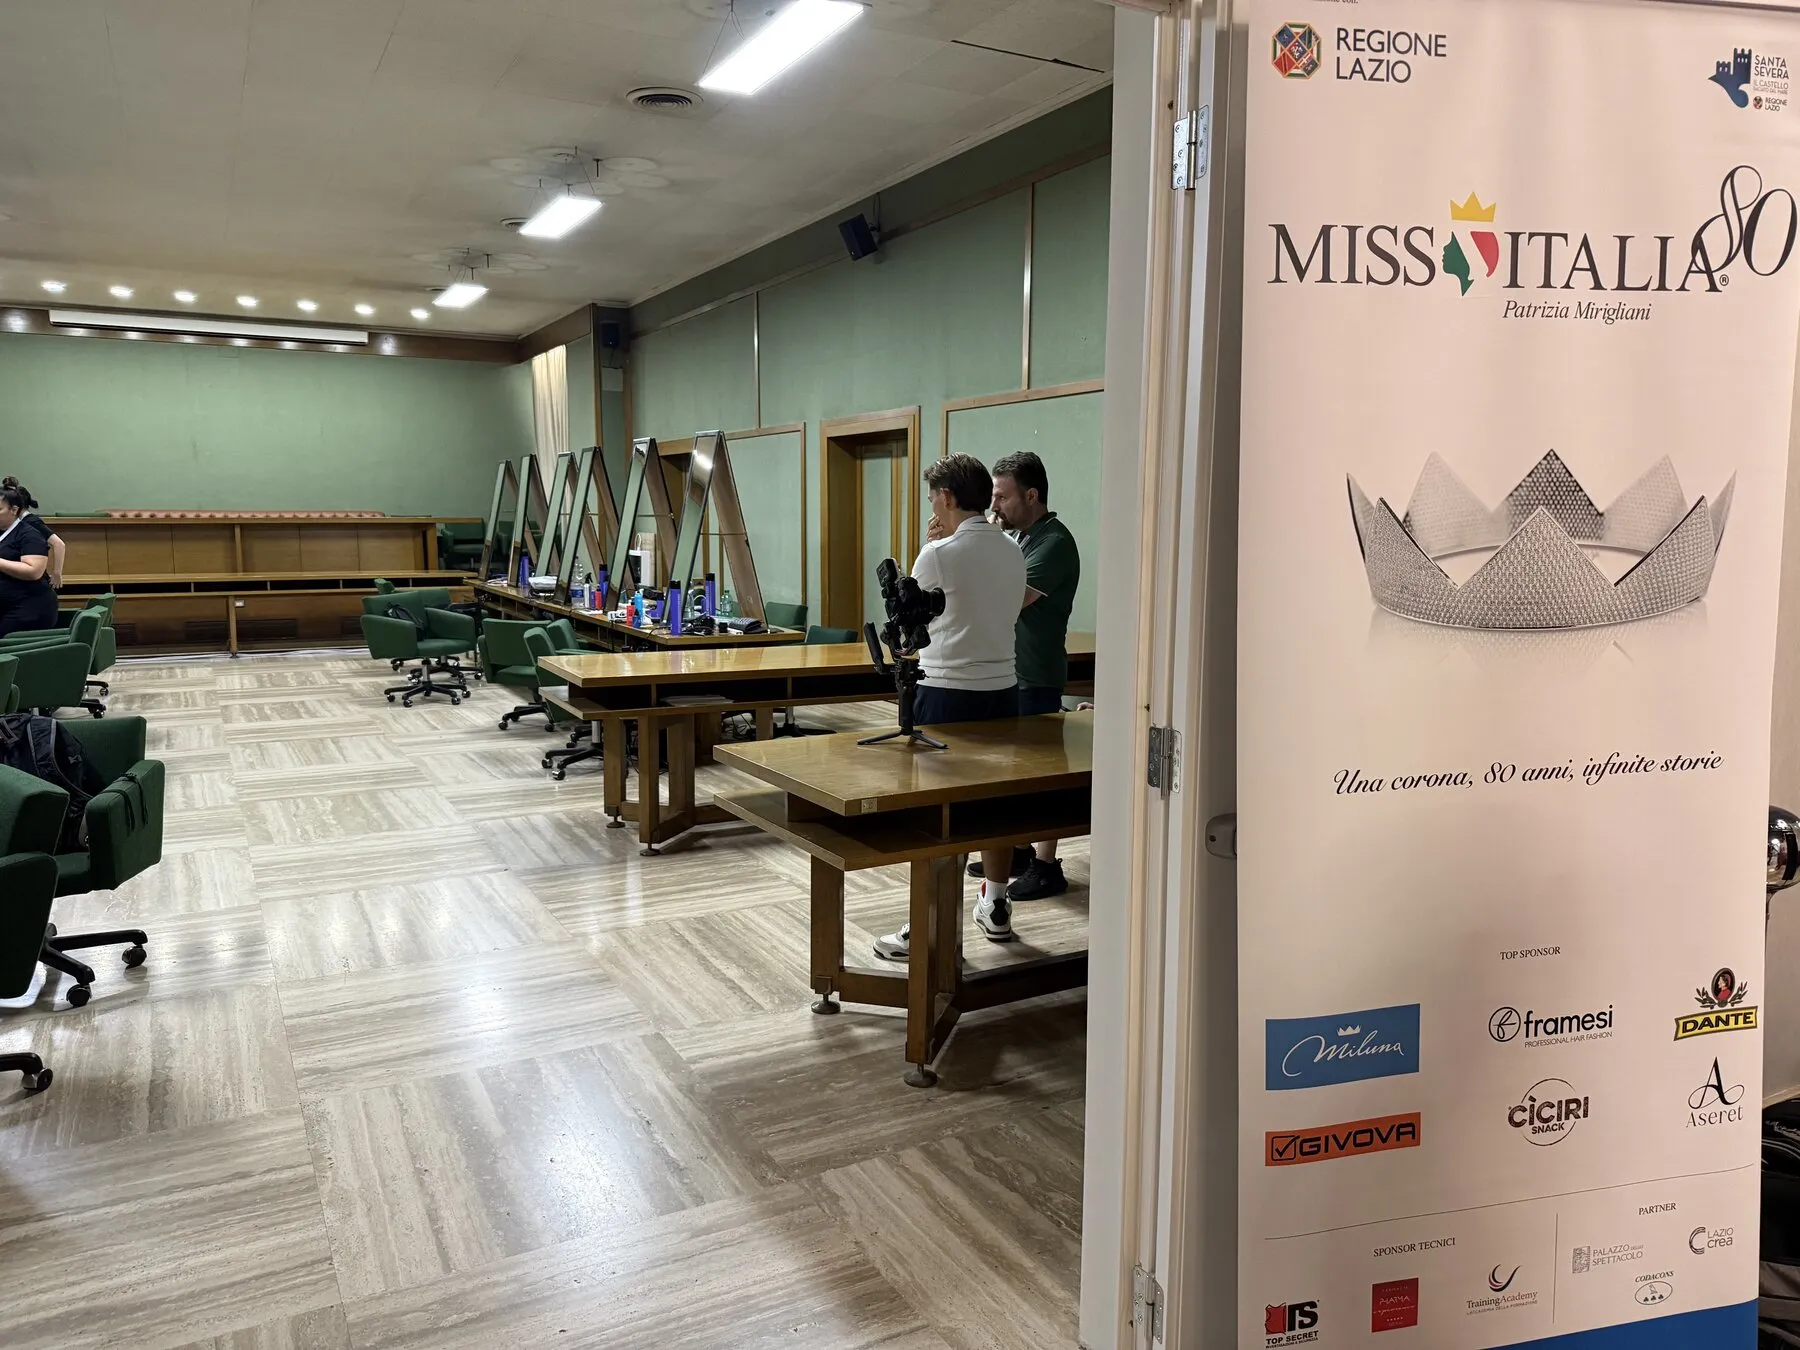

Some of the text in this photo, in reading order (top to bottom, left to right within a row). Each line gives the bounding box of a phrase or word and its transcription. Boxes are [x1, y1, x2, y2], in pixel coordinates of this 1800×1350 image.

[1336, 27, 1447, 57] REGIONE
[1754, 54, 1787, 68] SANTA
[1336, 57, 1412, 84] LAZIO
[1754, 66, 1789, 79] SEVERA
[1759, 80, 1789, 90] CASTELLO
[1765, 97, 1788, 106] REGIONE
[1765, 104, 1780, 112] LAZIO
[1267, 165, 1798, 293] MISS ITALIA 80
[1503, 300, 1652, 325] Patrizia Mirigliani
[1333, 750, 1724, 795] Una corona, 80 anni, infinite storie
[1500, 946, 1561, 960] TOP SPONSOR
[1524, 1005, 1613, 1038] framesi
[1681, 1012, 1754, 1034] DANTE
[1524, 1031, 1613, 1048] PROFESSIONAL HAIR FASHION
[1282, 1030, 1404, 1077] Miluna
[1685, 1105, 1744, 1128] Aseret
[1531, 1121, 1565, 1135] SNACK
[1299, 1122, 1416, 1157] GIVOVA
[1638, 1202, 1677, 1216] PARTNER
[1707, 1227, 1734, 1239] LAZIO
[1373, 1237, 1456, 1258] SPONSOR TECNICI
[1707, 1236, 1733, 1249] crea
[1592, 1244, 1630, 1257] PALAZZO
[1592, 1251, 1643, 1266] SPETTACOLO
[1635, 1270, 1675, 1283] CODACONS
[1265, 1330, 1319, 1345] TOP SECRET
